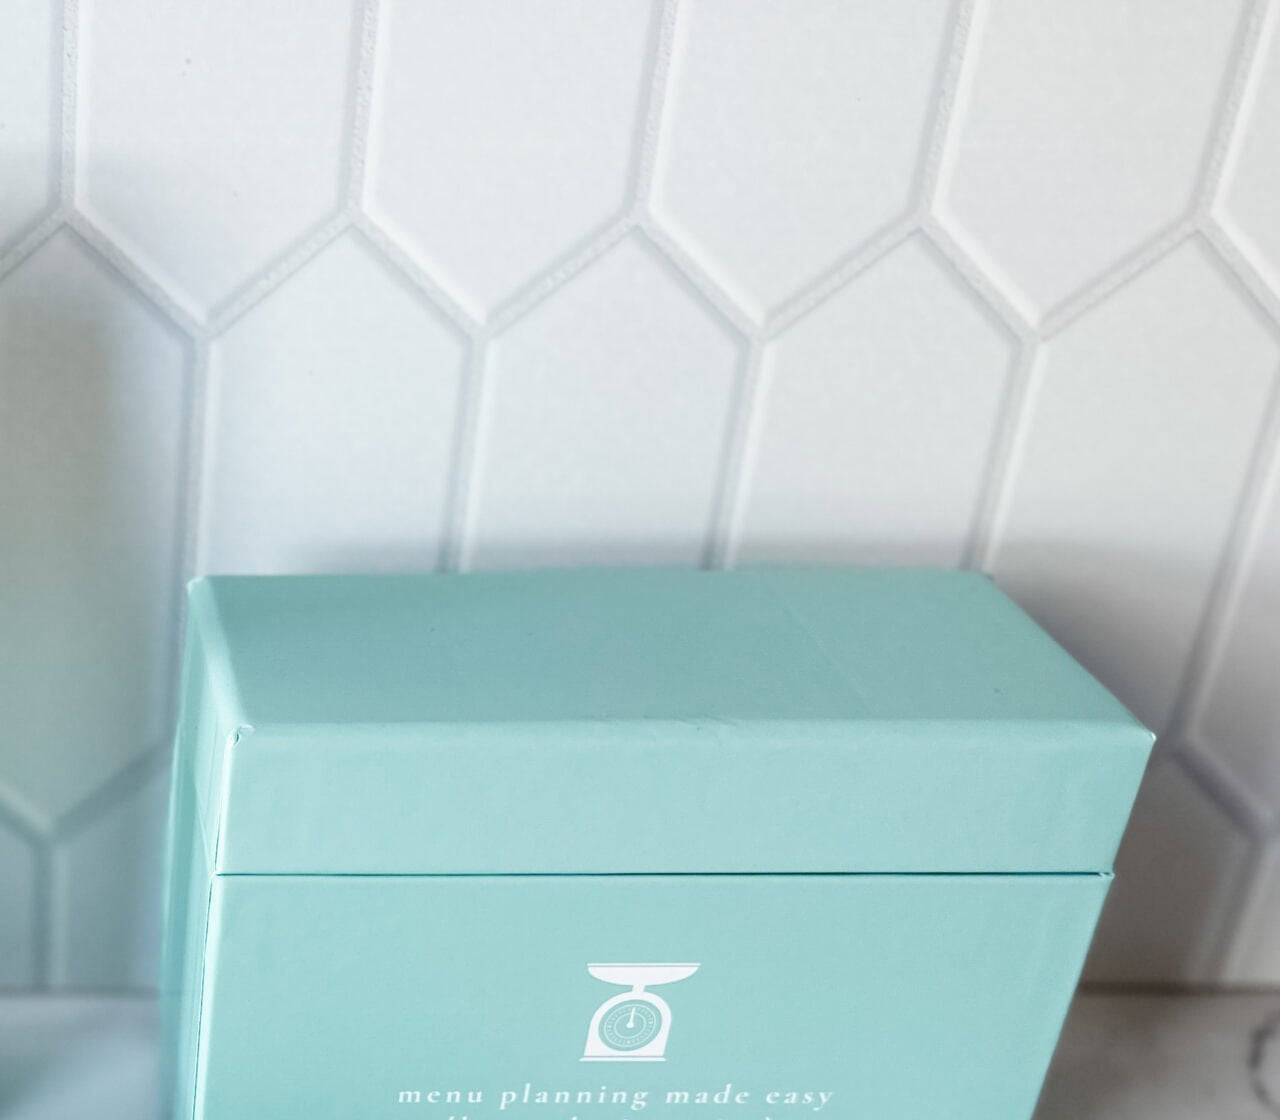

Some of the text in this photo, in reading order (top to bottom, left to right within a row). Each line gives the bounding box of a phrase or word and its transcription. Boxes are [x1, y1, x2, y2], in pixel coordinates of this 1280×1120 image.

[398, 1083, 834, 1111] menu planning made easy
